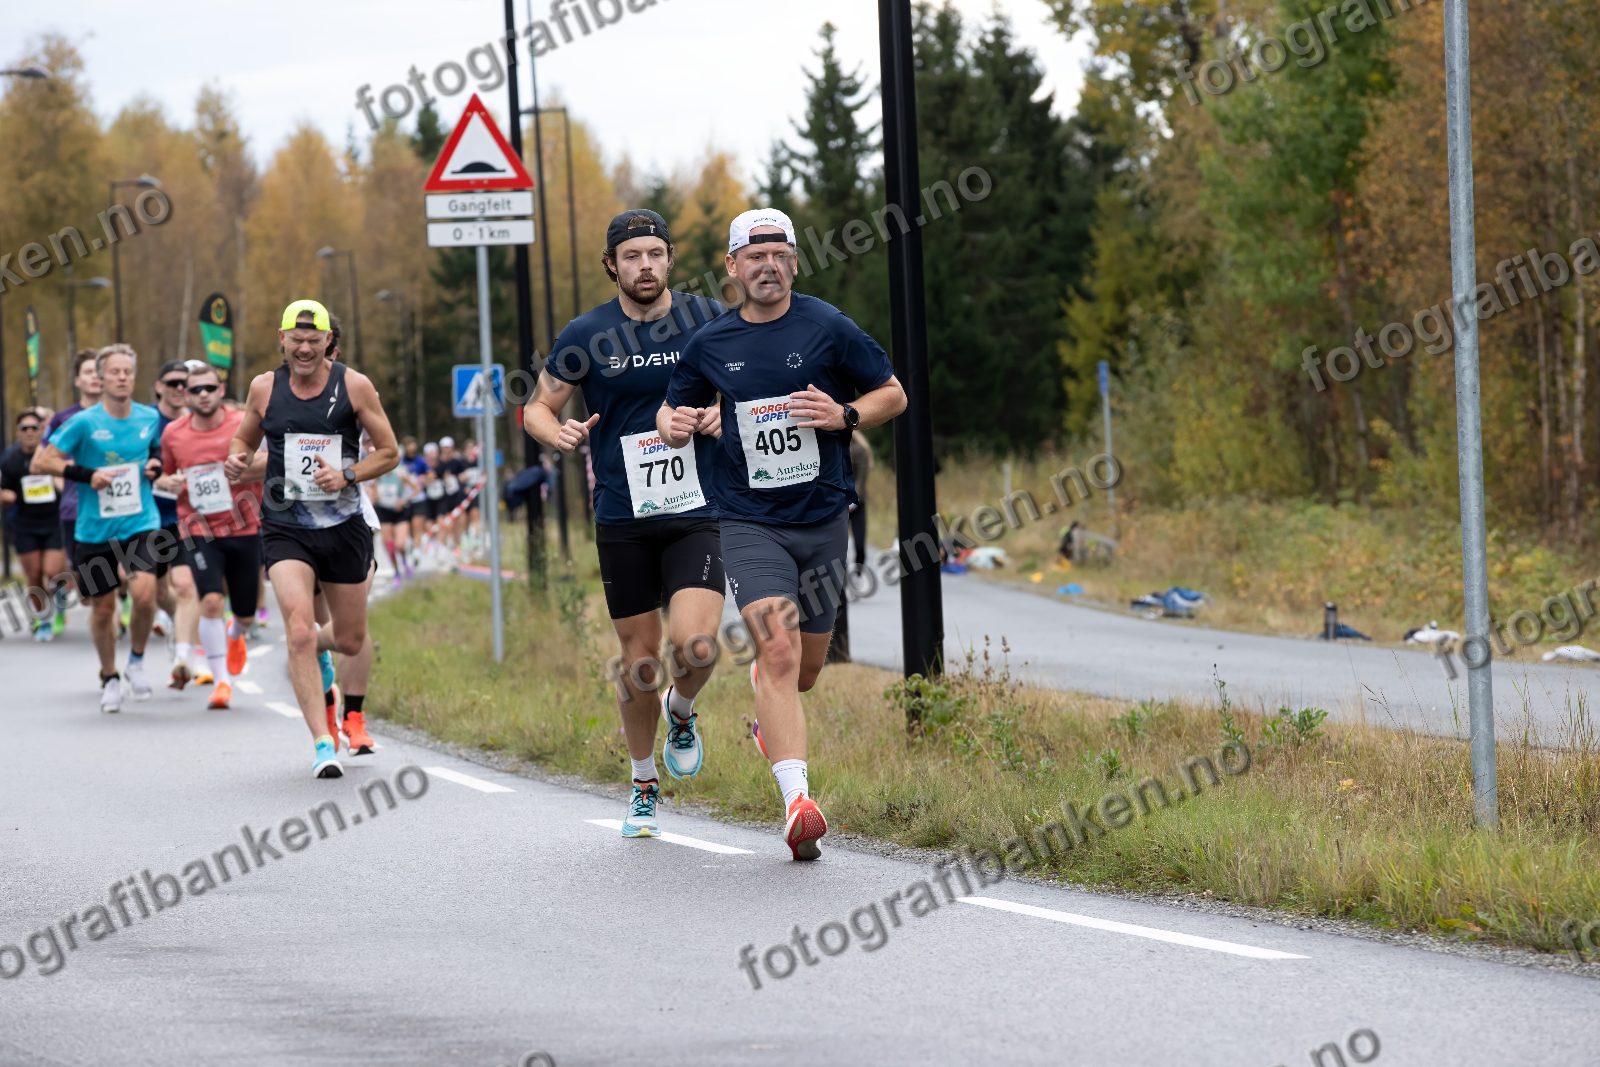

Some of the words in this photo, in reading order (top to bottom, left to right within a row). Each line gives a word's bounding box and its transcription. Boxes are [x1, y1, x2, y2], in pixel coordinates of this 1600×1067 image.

[448, 199, 512, 213] Gangfelt
[453, 228, 463, 241] 0
[755, 425, 802, 456] 405
[642, 443, 673, 456] LØPE
[639, 455, 685, 488] 770
[775, 460, 819, 477] Aurskog
[106, 481, 133, 498] 422
[194, 478, 221, 498] 389
[663, 488, 702, 506] Aurskog
